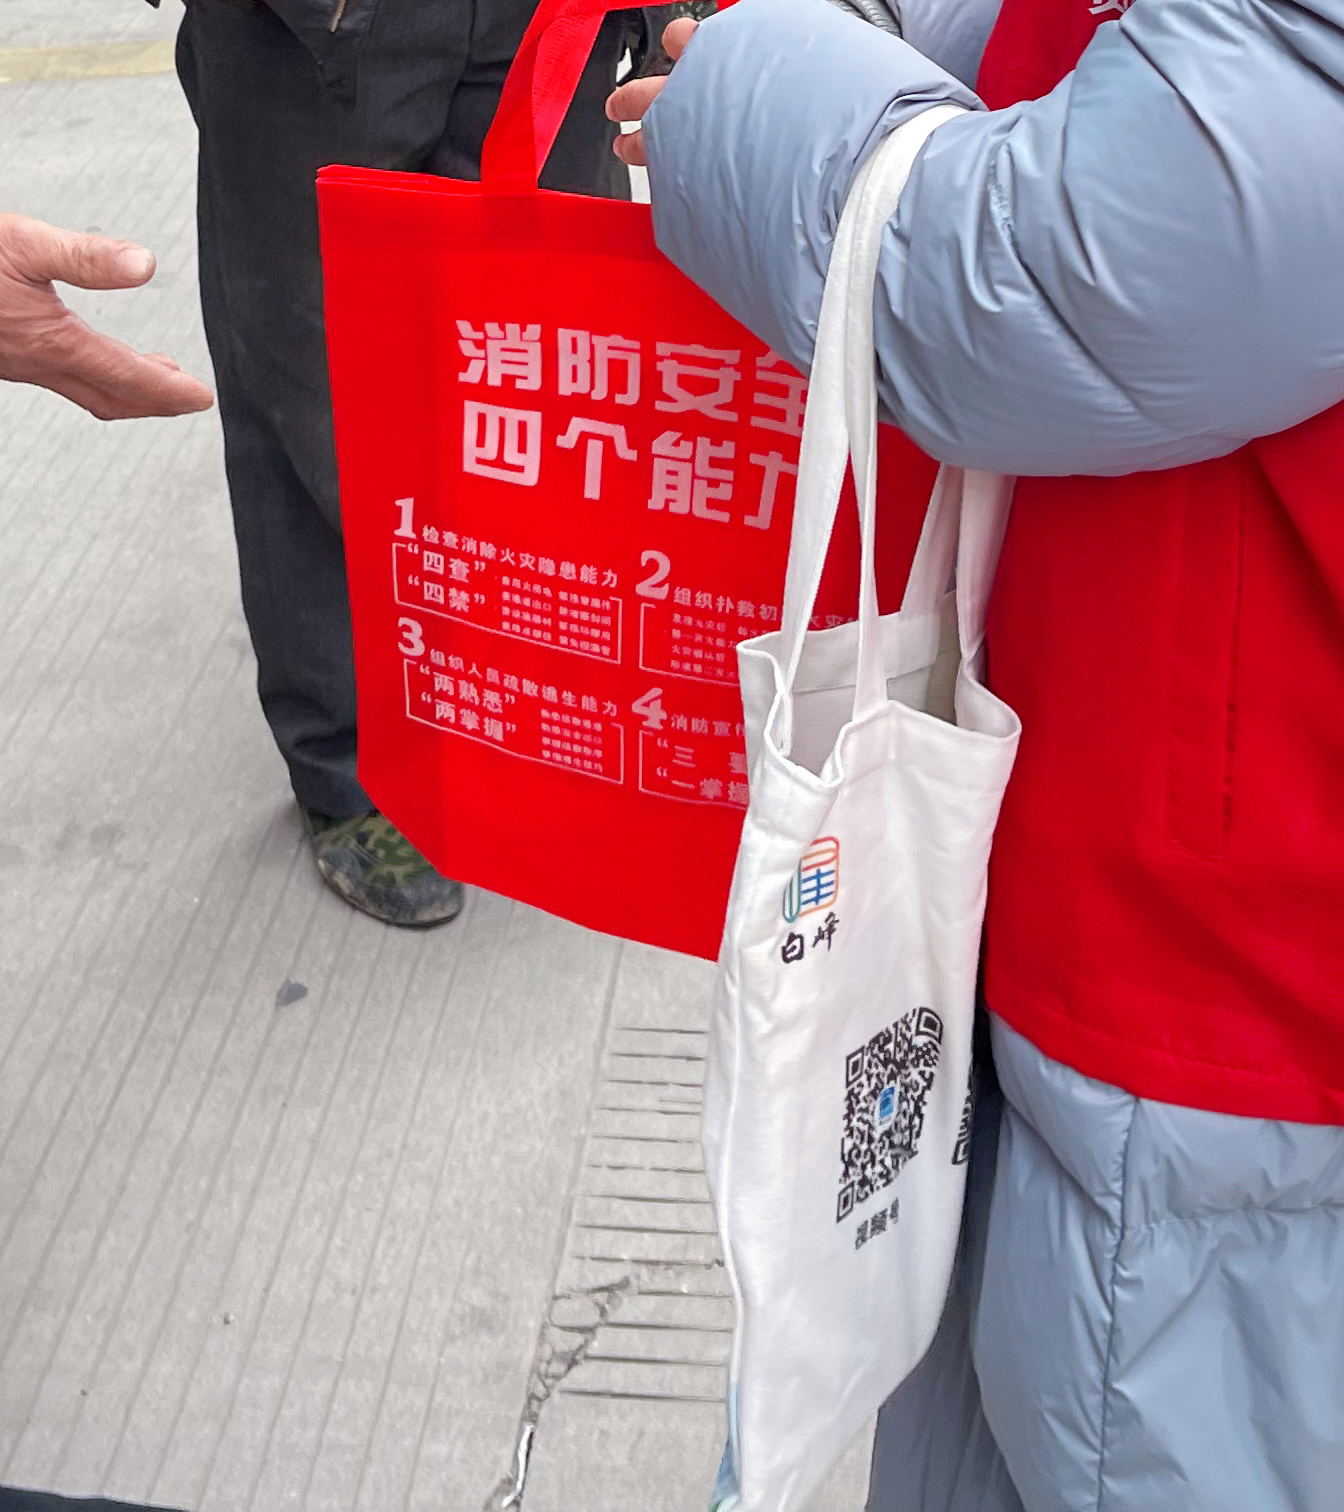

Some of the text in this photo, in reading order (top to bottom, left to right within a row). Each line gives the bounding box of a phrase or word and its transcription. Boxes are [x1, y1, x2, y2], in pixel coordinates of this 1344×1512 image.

[455, 318, 810, 438] 消防安全
[394, 497, 417, 539] 1
[635, 549, 671, 600] 2
[397, 616, 426, 657] 3
[631, 687, 668, 731] 4
